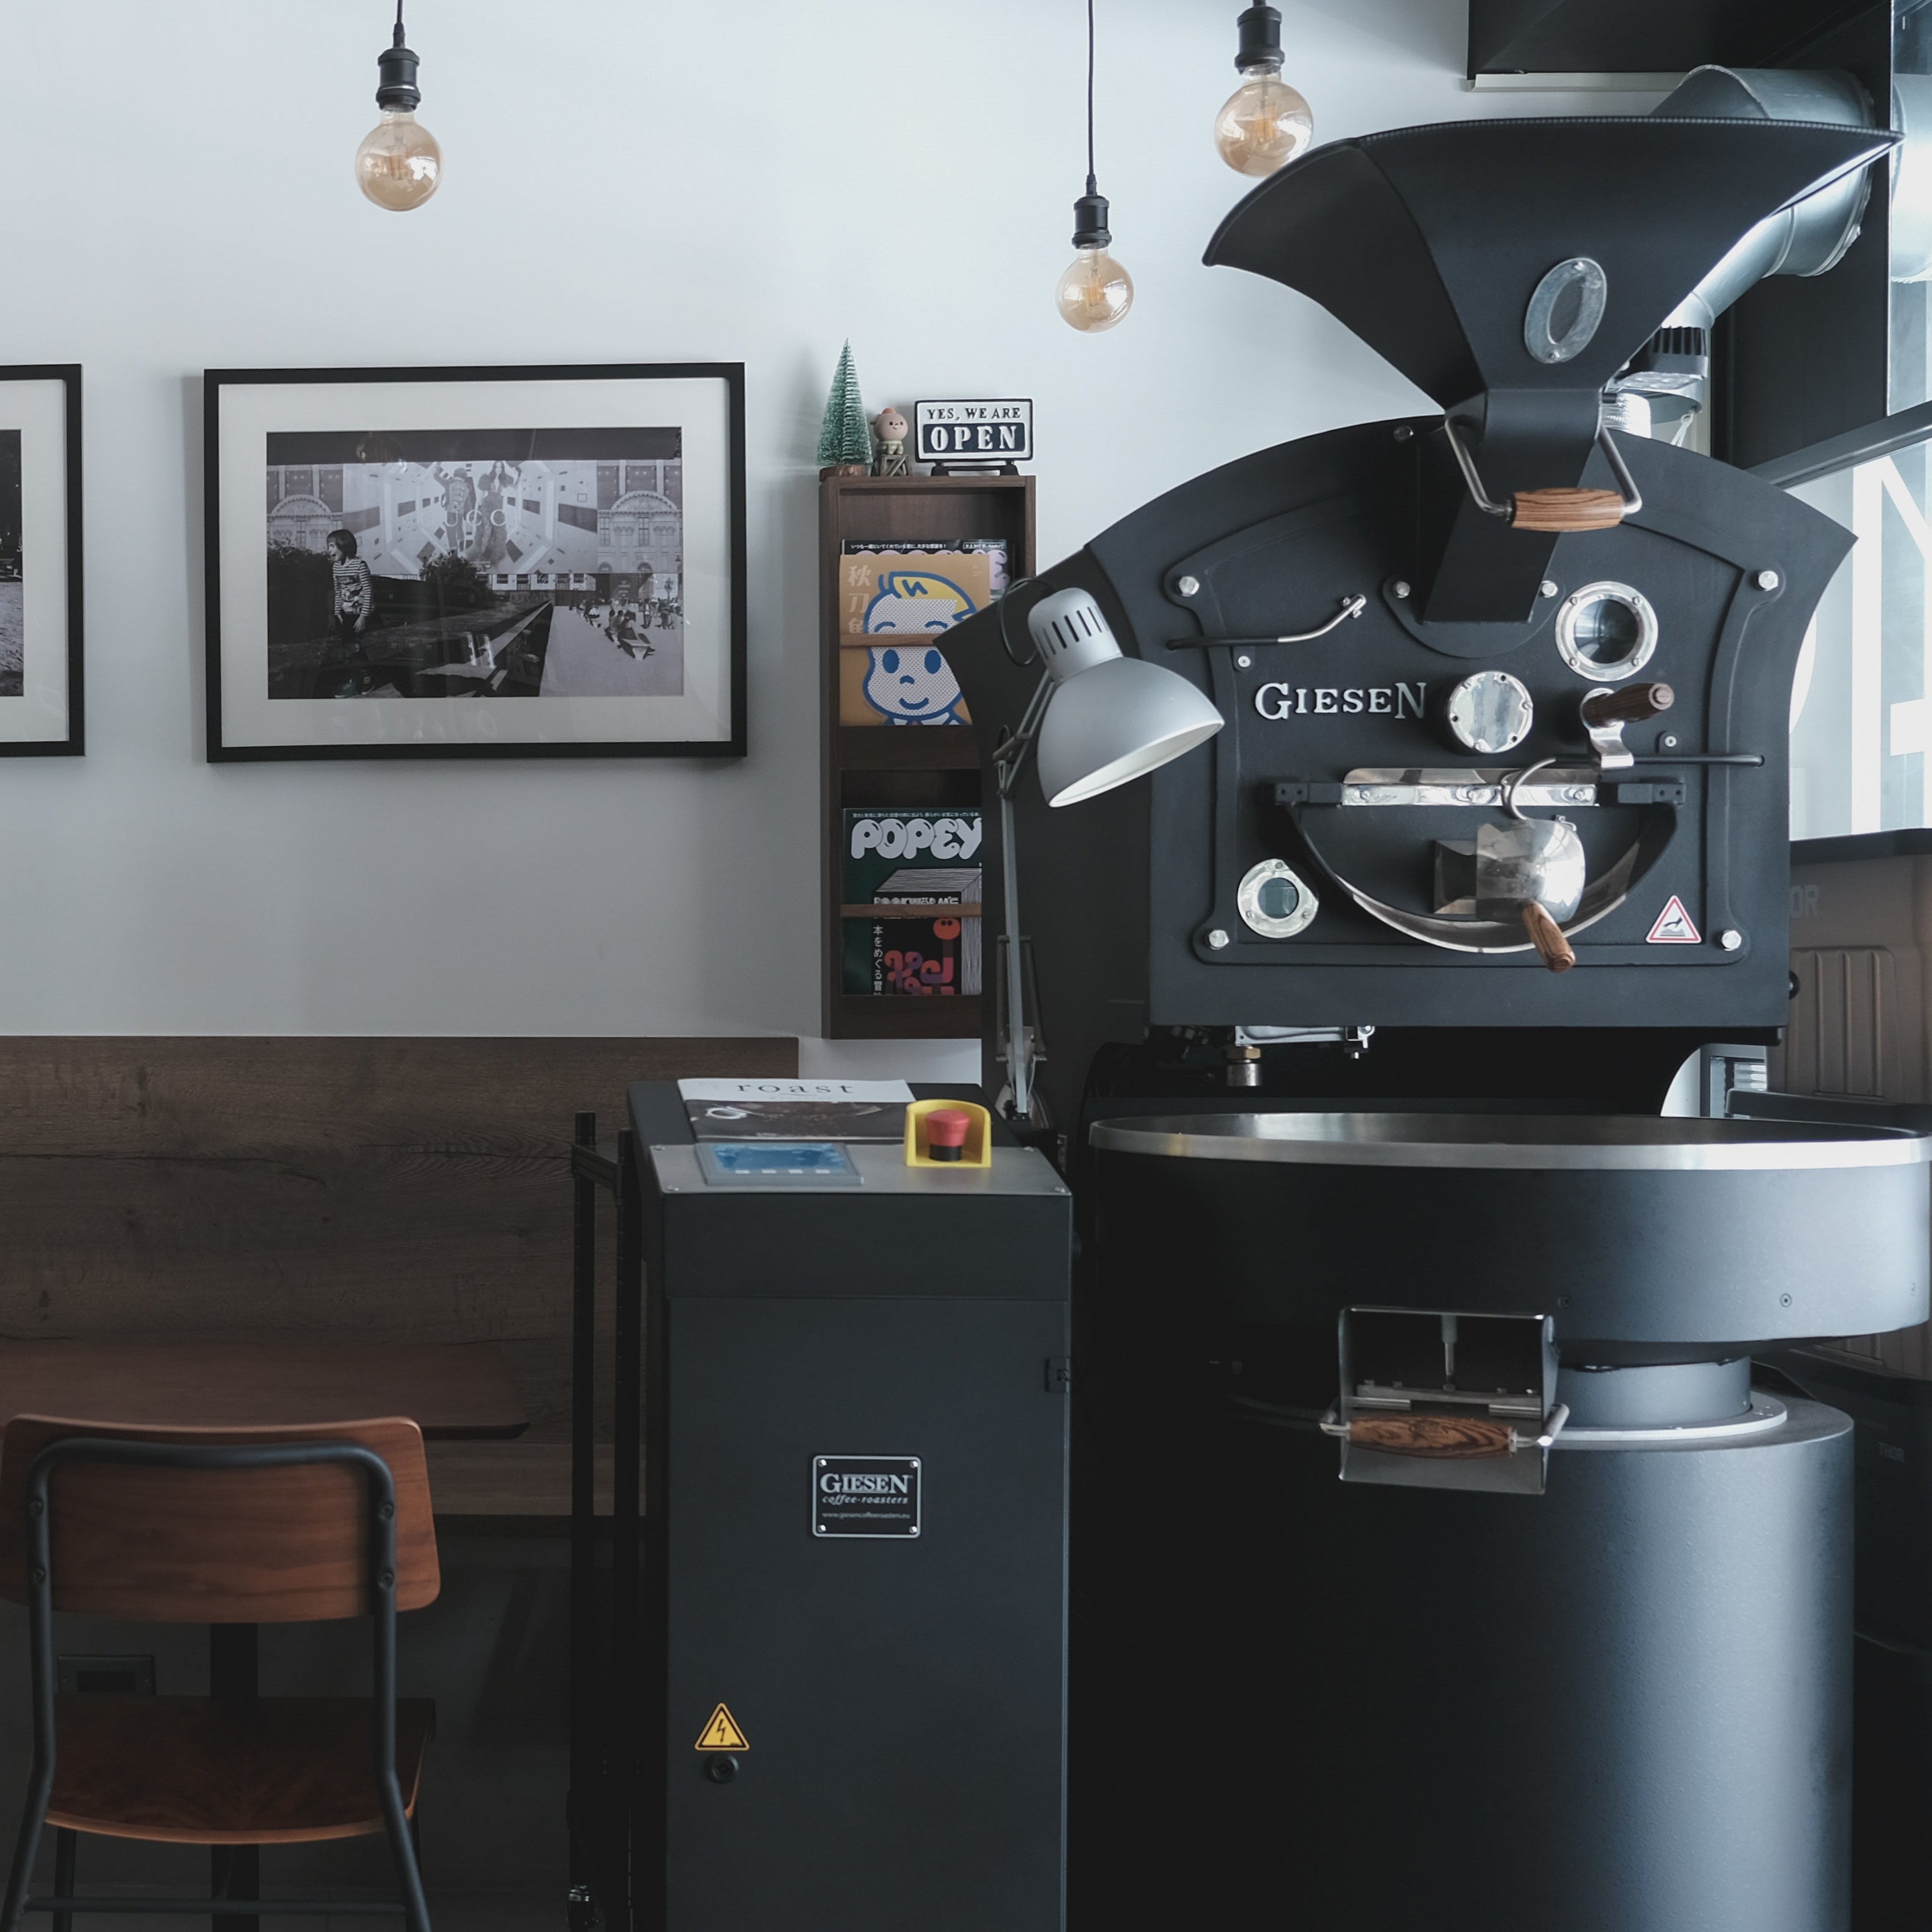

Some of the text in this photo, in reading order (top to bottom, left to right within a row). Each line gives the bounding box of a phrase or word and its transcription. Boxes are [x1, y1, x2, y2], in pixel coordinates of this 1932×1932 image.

[927, 407, 1021, 421] YES, WE ARE
[930, 425, 1017, 452] OPEN
[1254, 682, 1427, 720] GIESEN
[873, 925, 883, 996] 本をめぐる冒
[736, 1084, 854, 1094] roast
[819, 1473, 910, 1494] GIESEN
